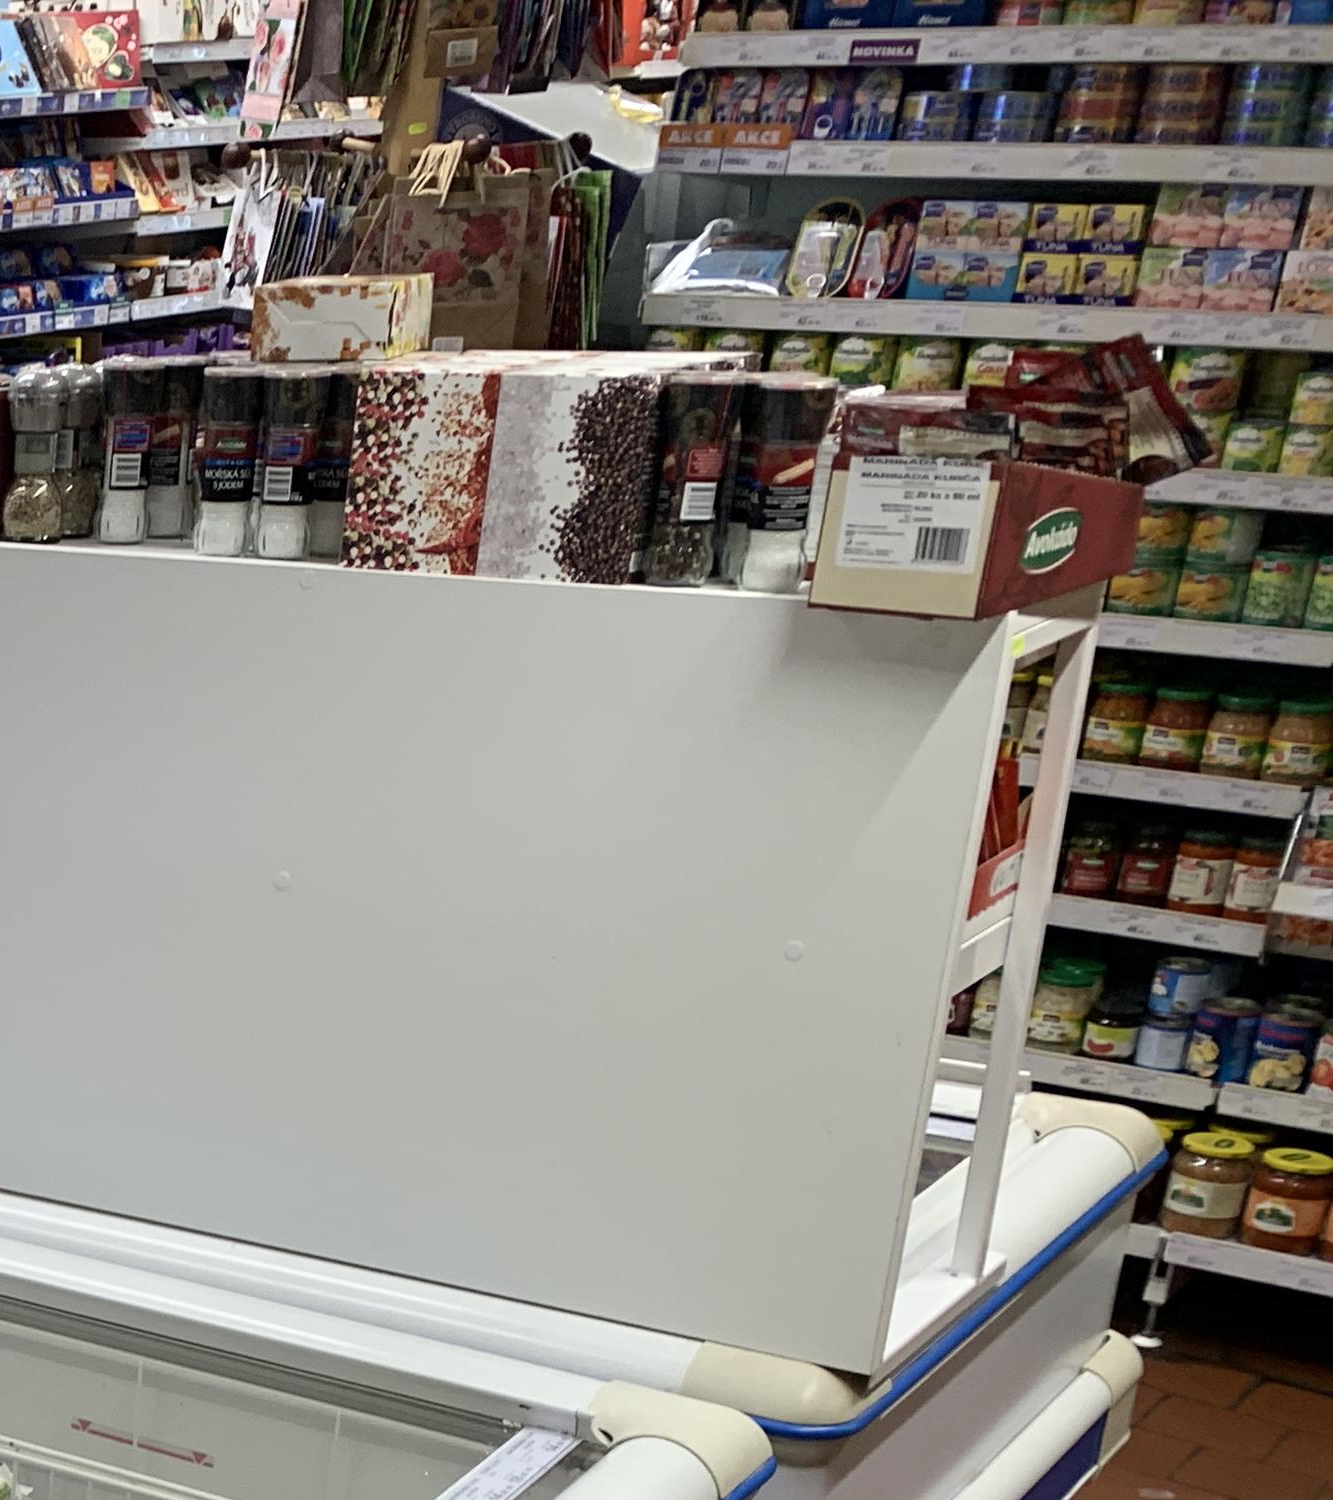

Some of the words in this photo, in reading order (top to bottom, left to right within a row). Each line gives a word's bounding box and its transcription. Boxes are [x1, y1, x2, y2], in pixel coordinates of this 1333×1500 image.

[852, 44, 915, 58] NOVINKA
[667, 130, 715, 144] AKCE
[732, 131, 781, 145] AKCE
